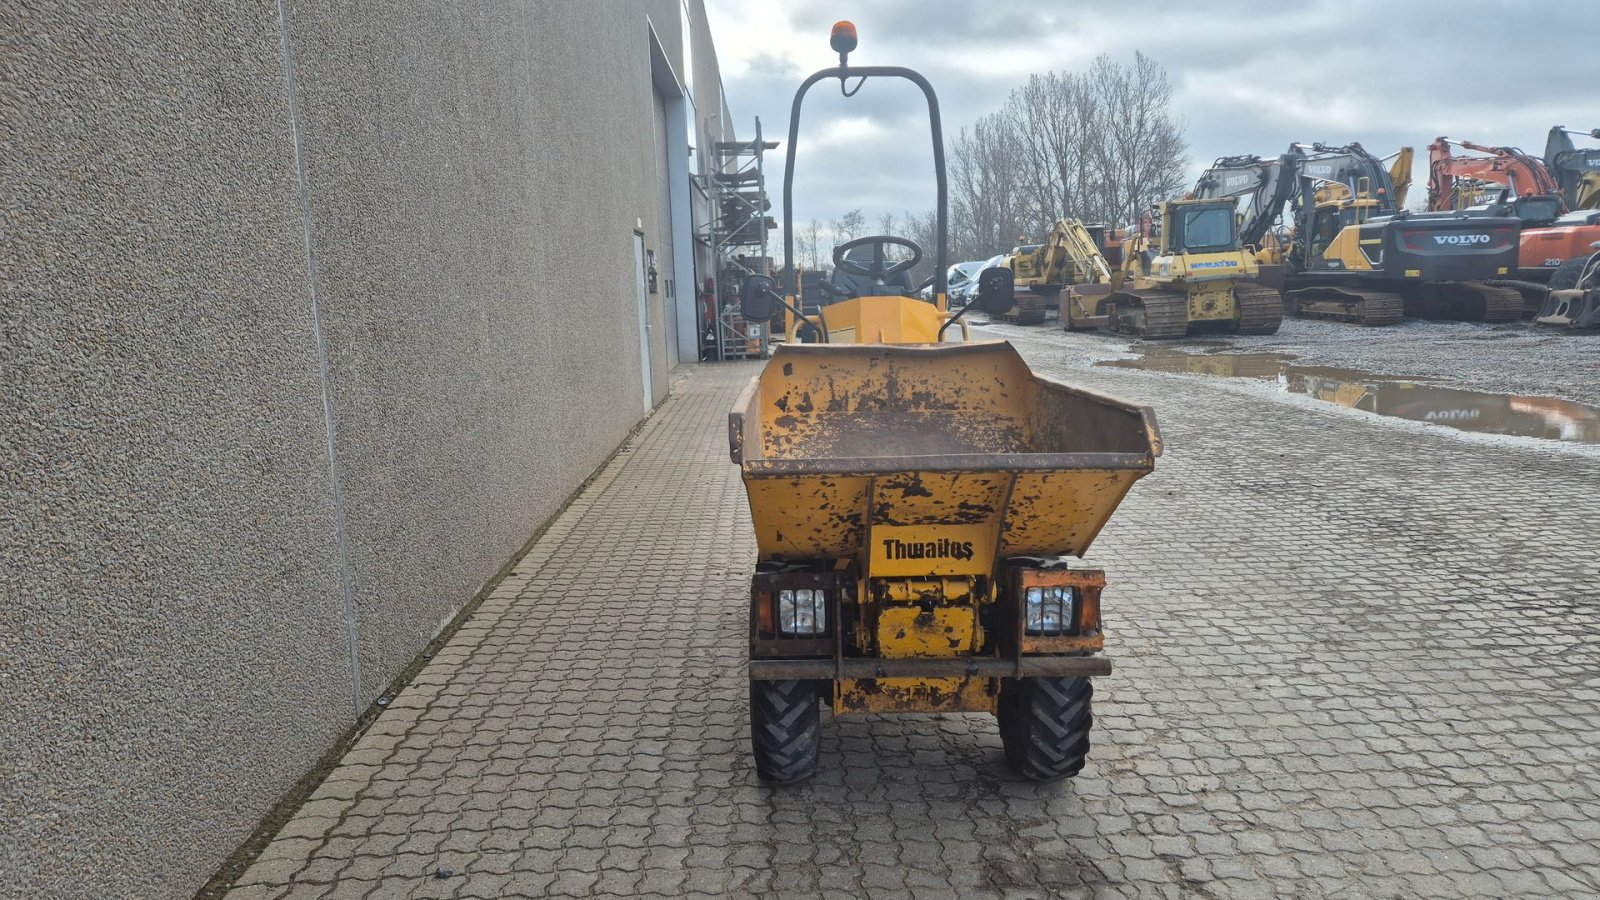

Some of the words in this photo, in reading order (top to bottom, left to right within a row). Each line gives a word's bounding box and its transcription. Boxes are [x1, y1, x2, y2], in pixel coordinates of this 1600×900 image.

[1308, 165, 1331, 174] VOLVO
[1226, 175, 1248, 187] VOLVO
[1433, 235, 1490, 245] VOLVO
[1190, 260, 1238, 269] KOMATSU
[1545, 258, 1560, 266] 210
[883, 539, 974, 561] Thwaites
